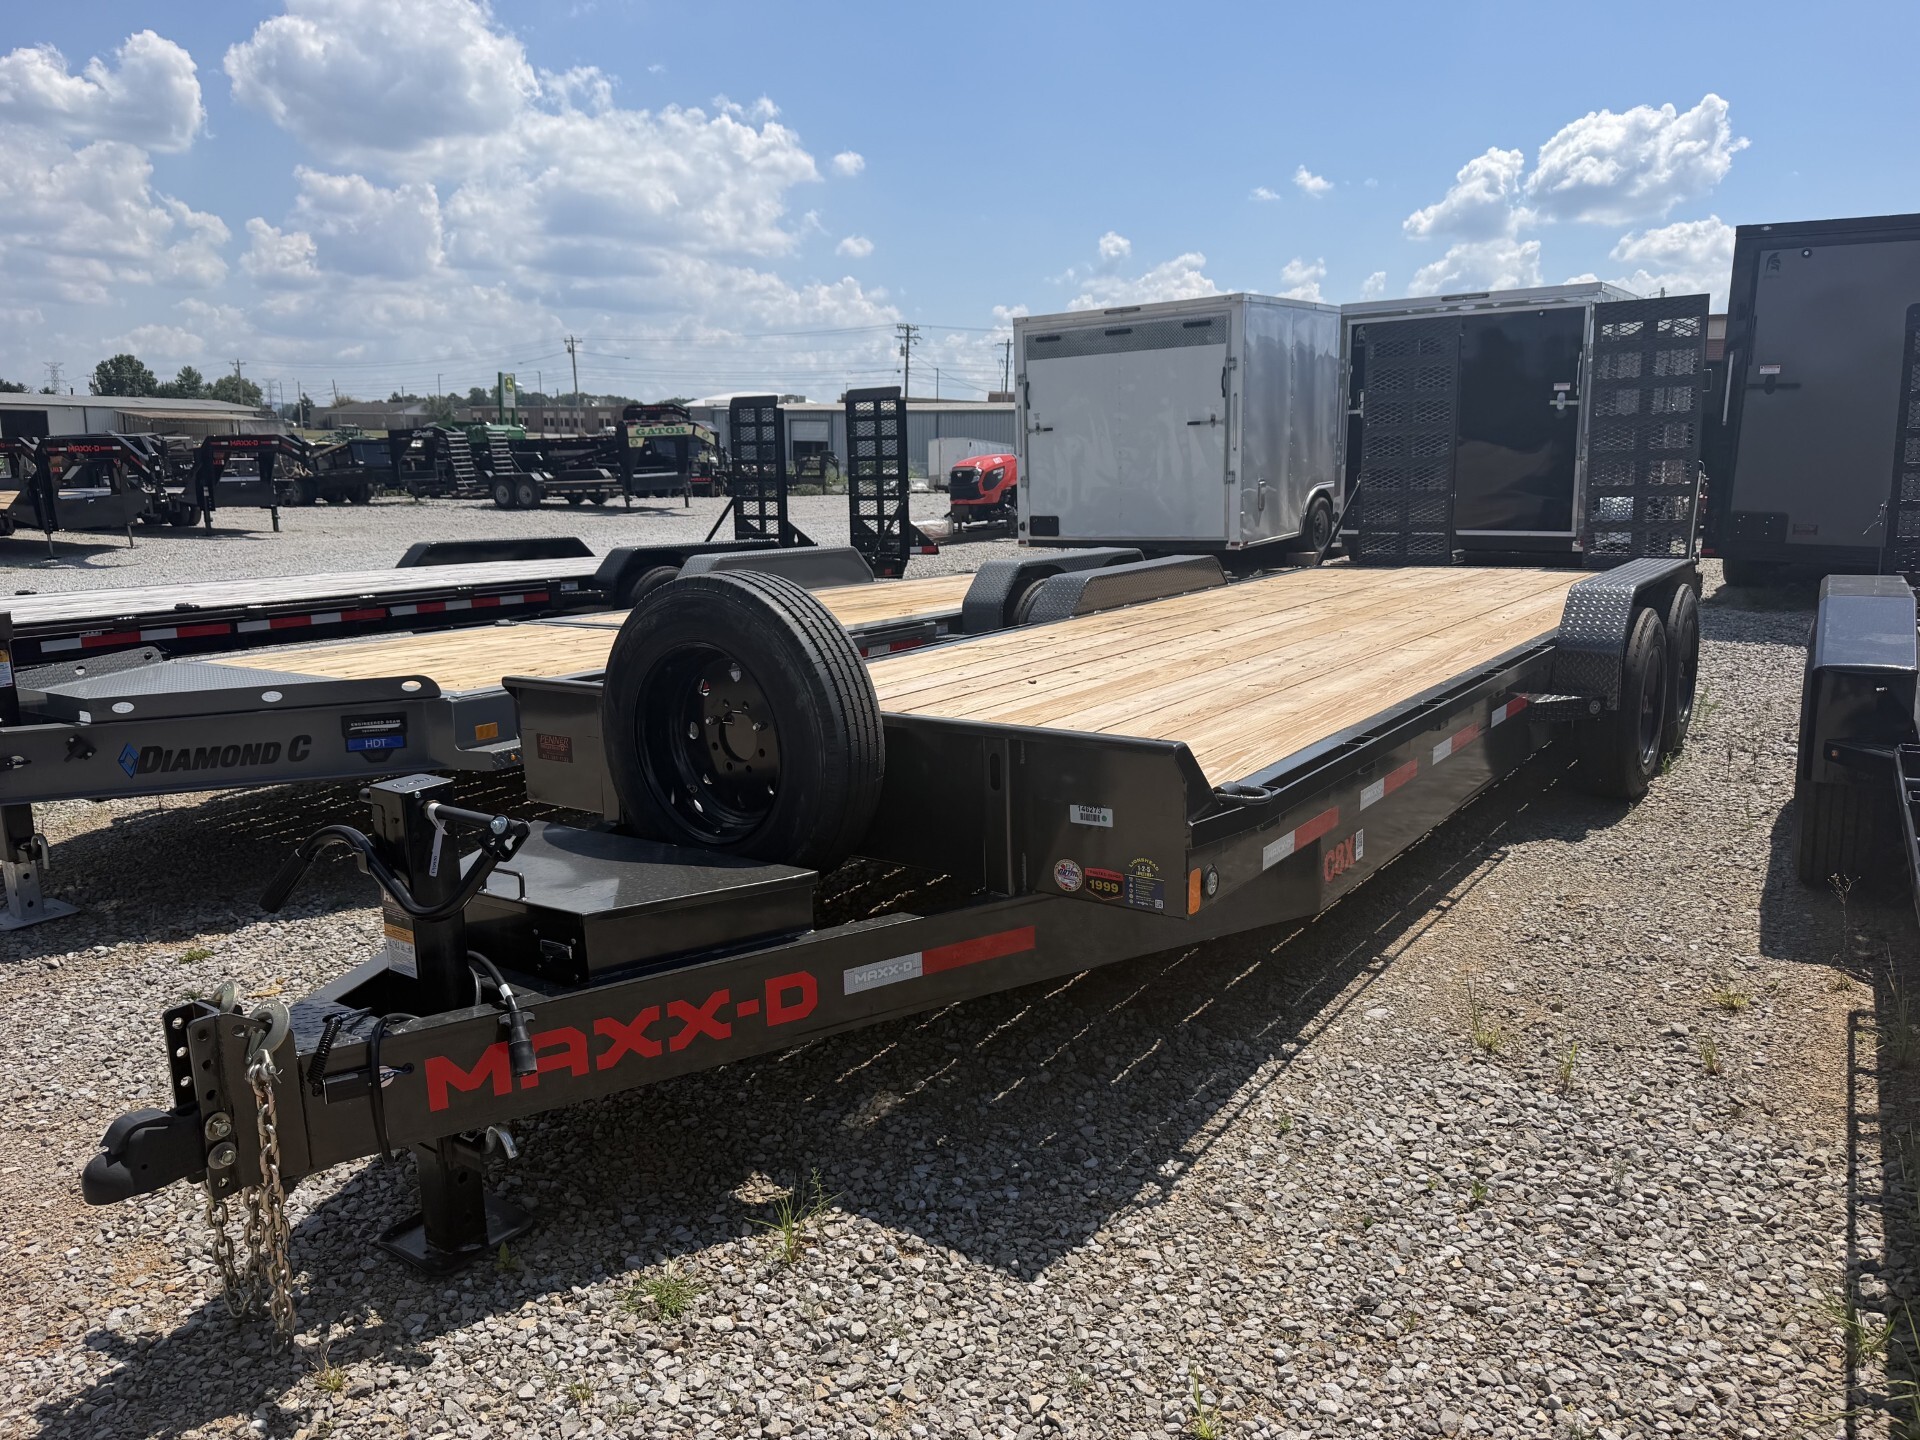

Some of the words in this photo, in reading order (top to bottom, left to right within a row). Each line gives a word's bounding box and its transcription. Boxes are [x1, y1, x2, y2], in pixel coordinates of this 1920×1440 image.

[636, 426, 687, 436] GATOR
[68, 445, 100, 453] MAXX-D
[365, 738, 387, 748] HDT
[136, 742, 282, 774] DIAMOND
[287, 734, 312, 763] C
[1323, 833, 1355, 882] C8X
[1089, 879, 1119, 893] 1999
[853, 961, 914, 985] MAXX-D
[424, 970, 818, 1113] MAXX-D
